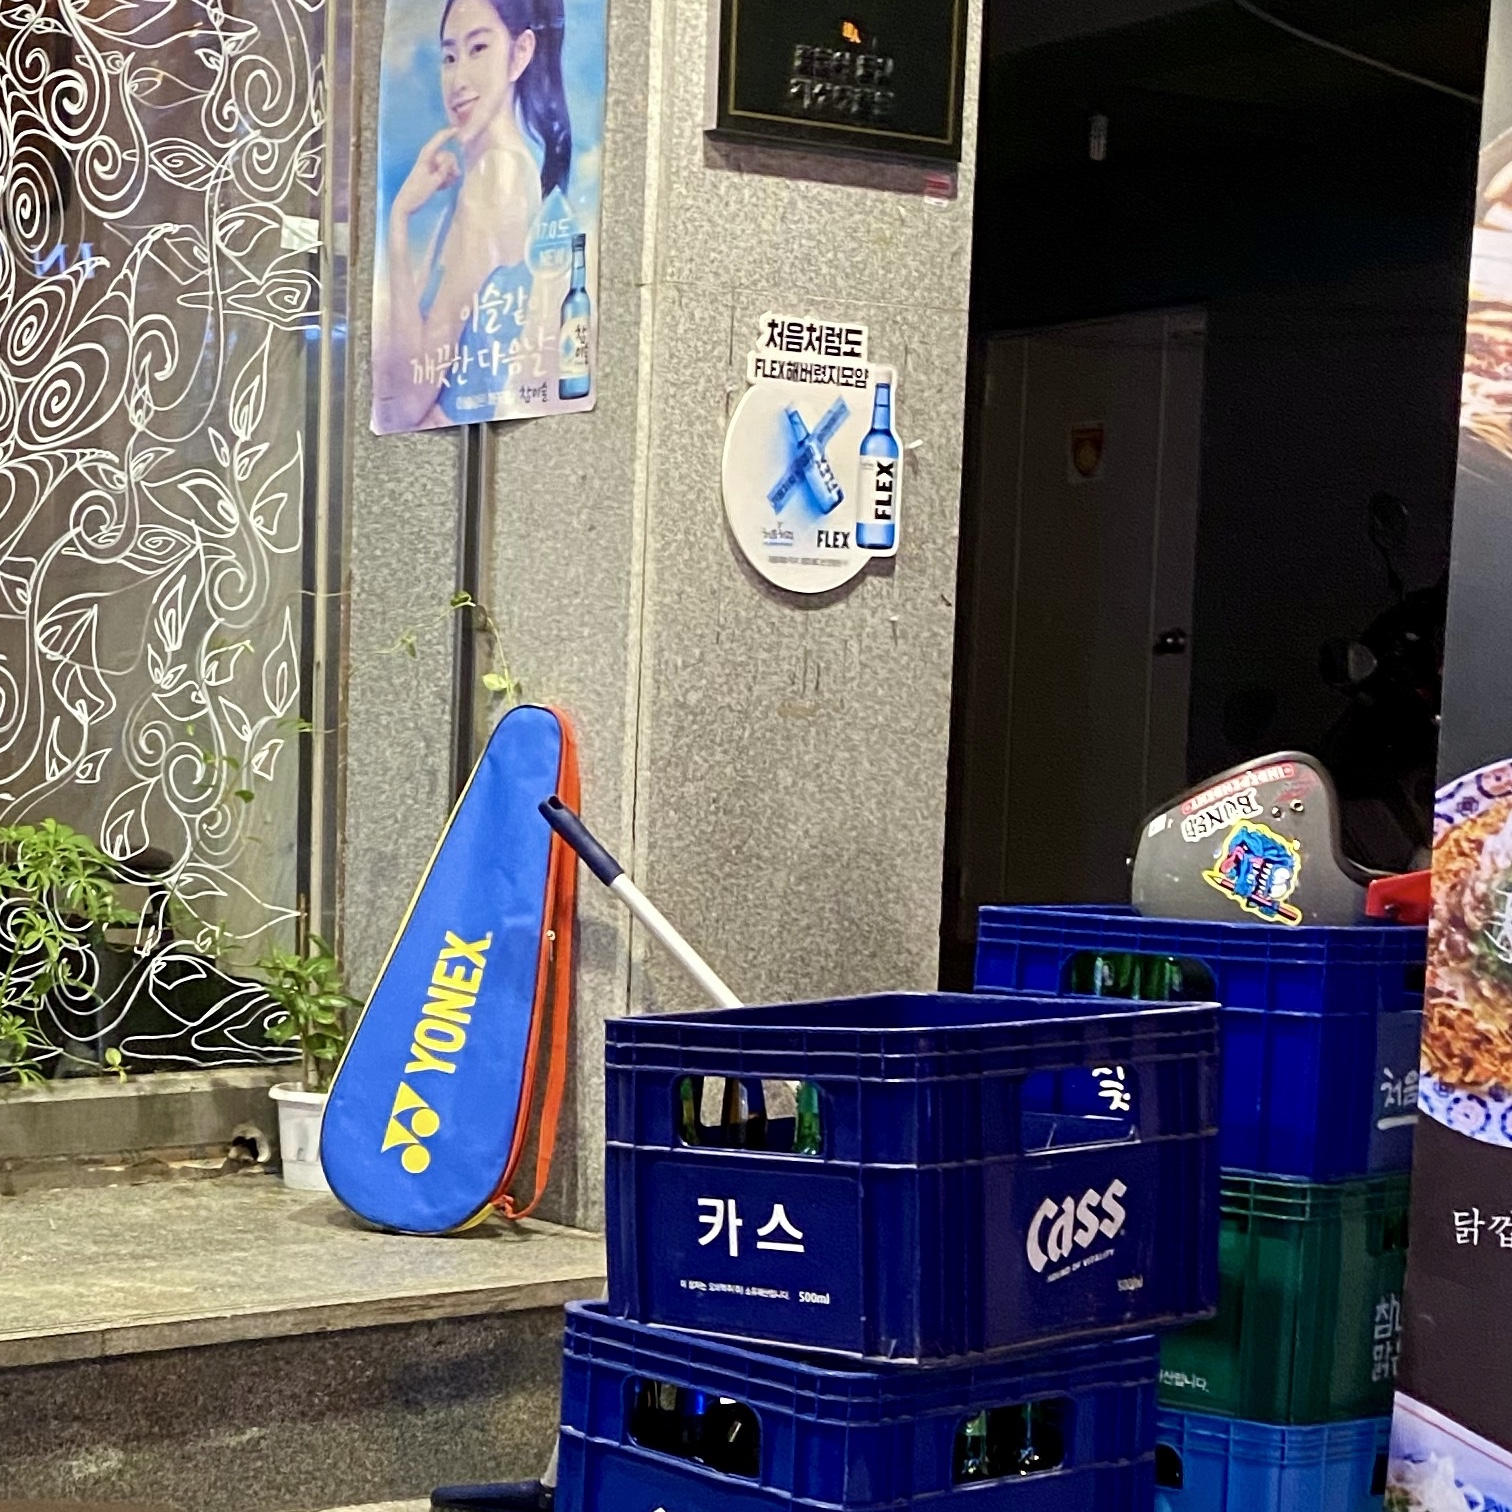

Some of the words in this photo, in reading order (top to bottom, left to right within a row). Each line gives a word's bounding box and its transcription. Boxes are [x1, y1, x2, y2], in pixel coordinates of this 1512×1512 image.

[765, 318, 863, 358] 처음처럼도
[874, 461, 895, 520] FLEX
[817, 530, 850, 549] FLEX
[404, 931, 492, 1074] YONEX
[798, 1290, 831, 1305] 500ml
